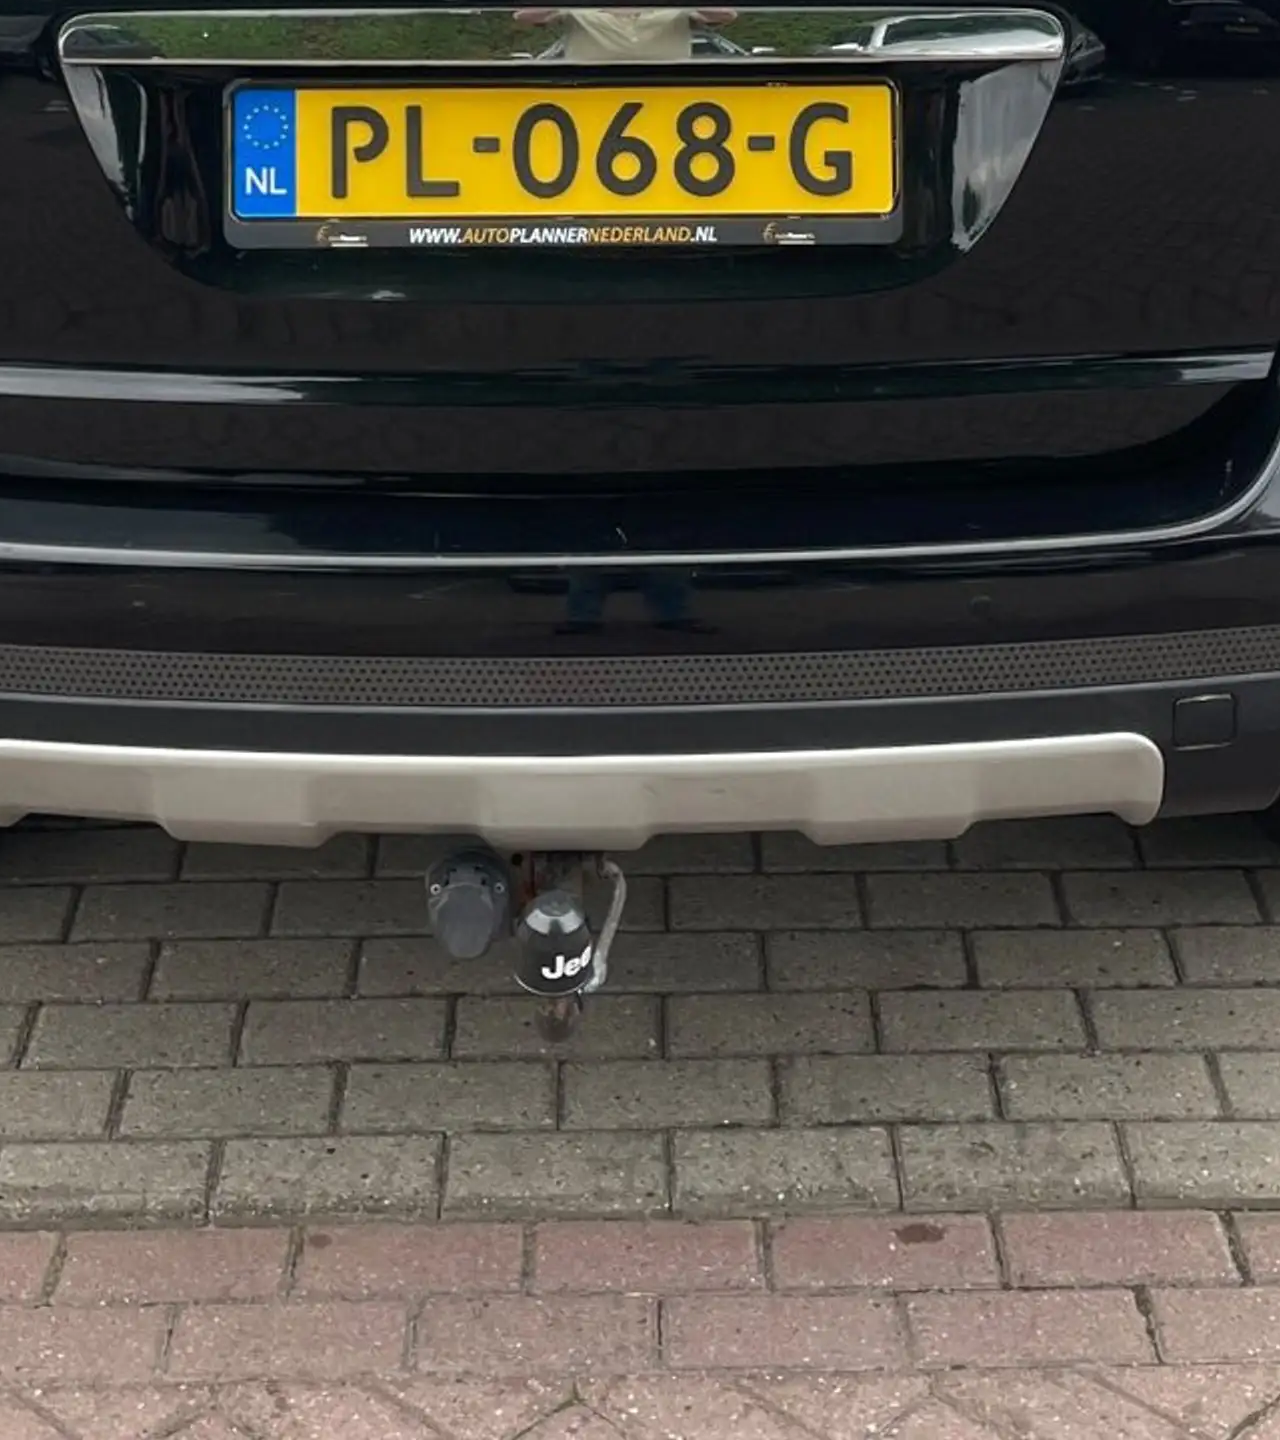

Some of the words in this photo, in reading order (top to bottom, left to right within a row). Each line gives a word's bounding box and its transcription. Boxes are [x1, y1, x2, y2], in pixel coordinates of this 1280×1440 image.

[331, 102, 853, 199] PL-068-G
[245, 167, 288, 195] NL
[409, 226, 718, 244] WWW.AUTOPLANNERNEDERLAND.NL
